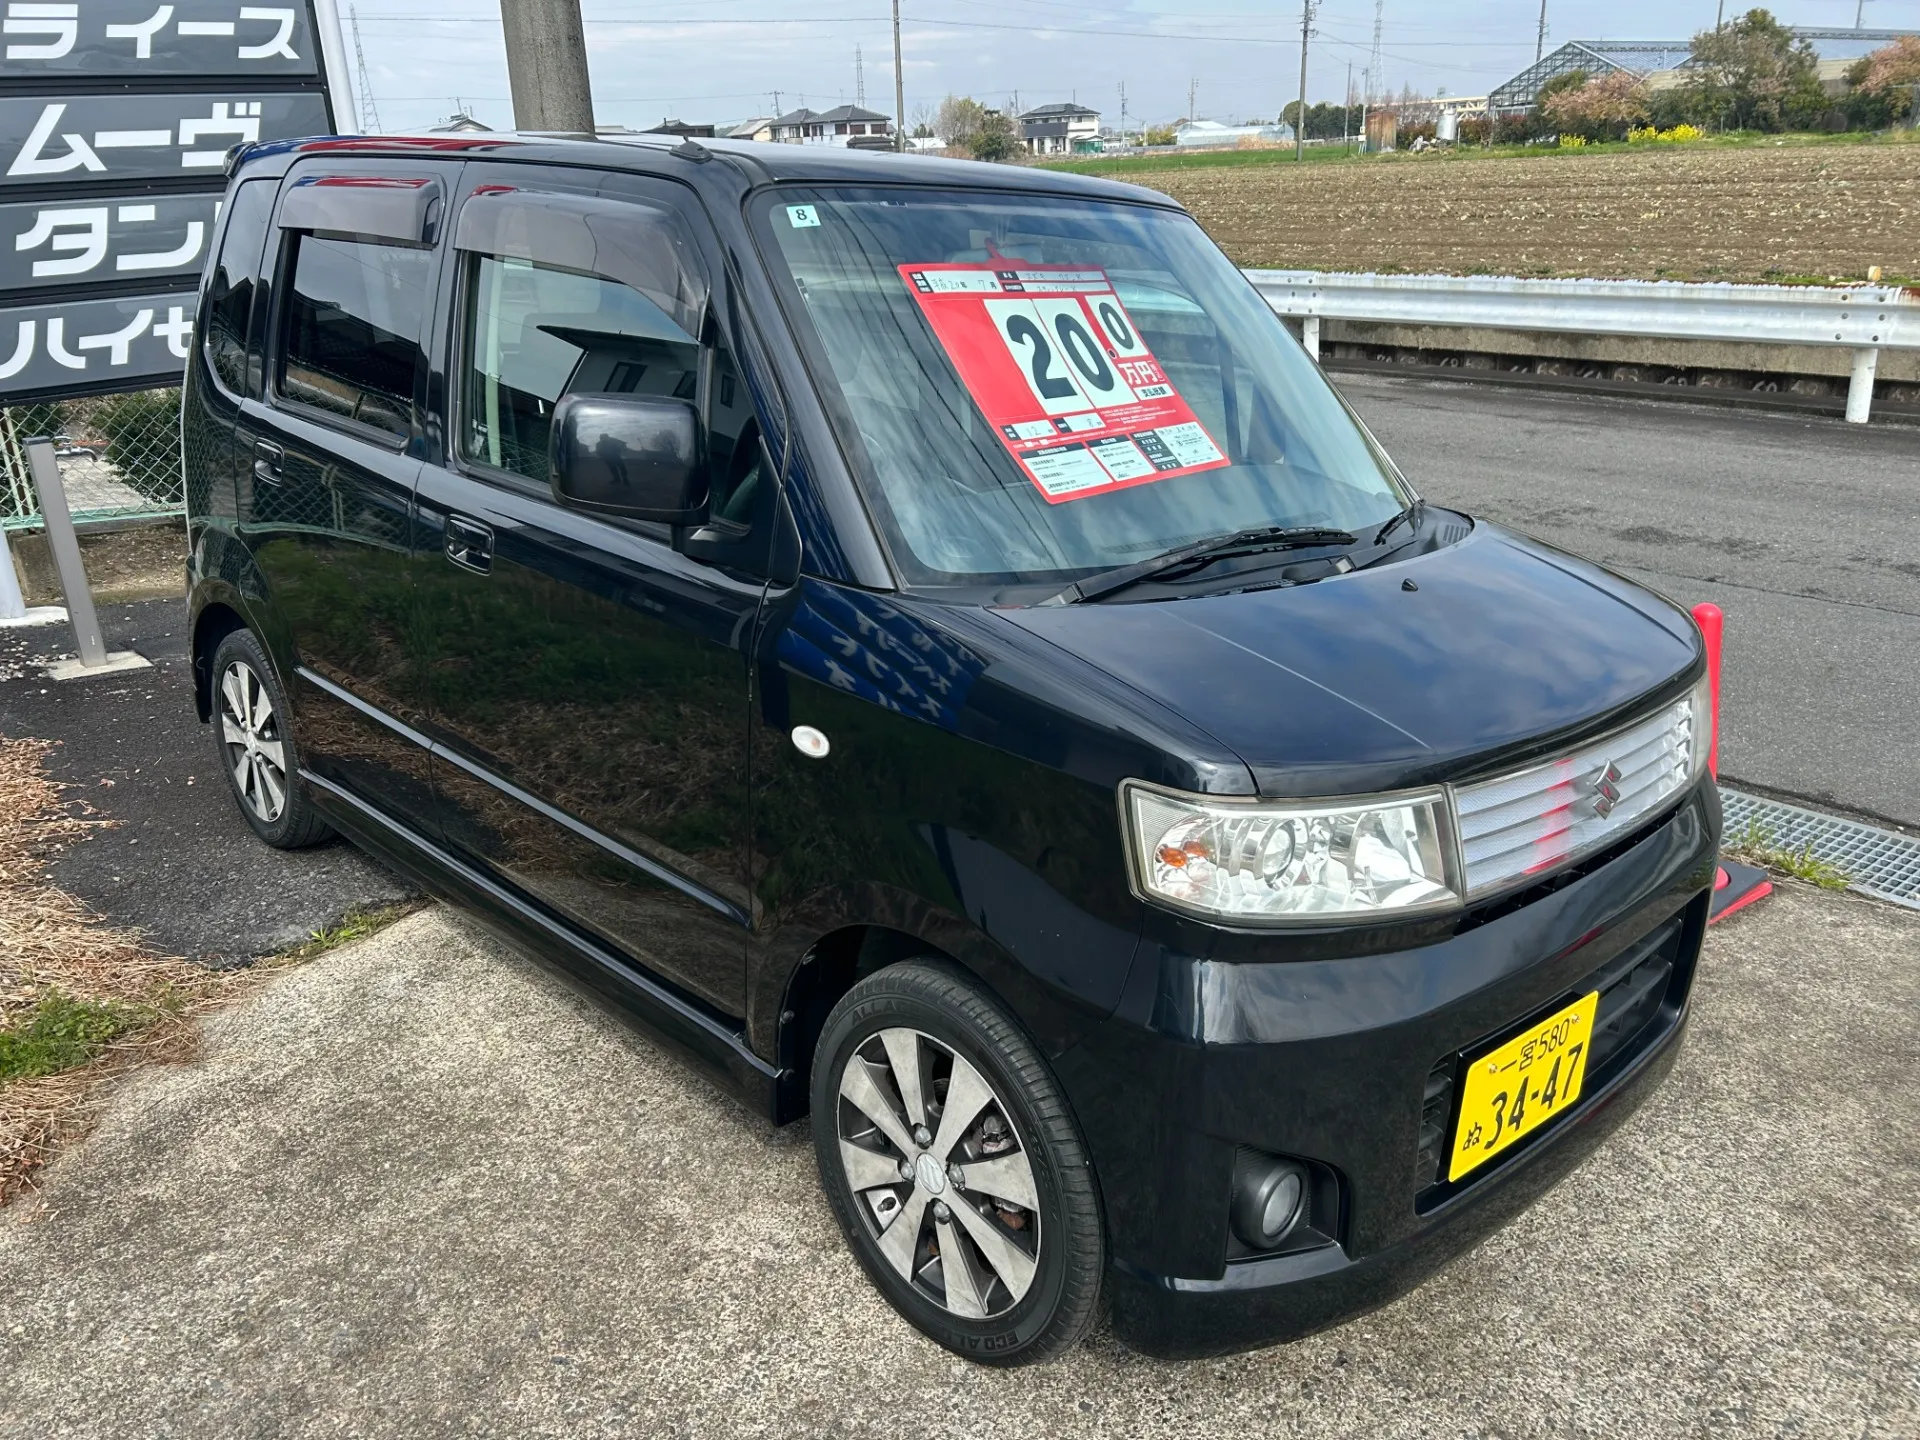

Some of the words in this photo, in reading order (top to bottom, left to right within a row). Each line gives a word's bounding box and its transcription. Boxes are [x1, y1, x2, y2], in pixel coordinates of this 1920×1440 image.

[7, 102, 261, 176] ムーヴ
[15, 201, 223, 277] タン
[795, 208, 807, 221] 8
[1118, 361, 1158, 386] 万円
[1463, 1121, 1482, 1151] ぬ
[1484, 1041, 1584, 1151] 34-47
